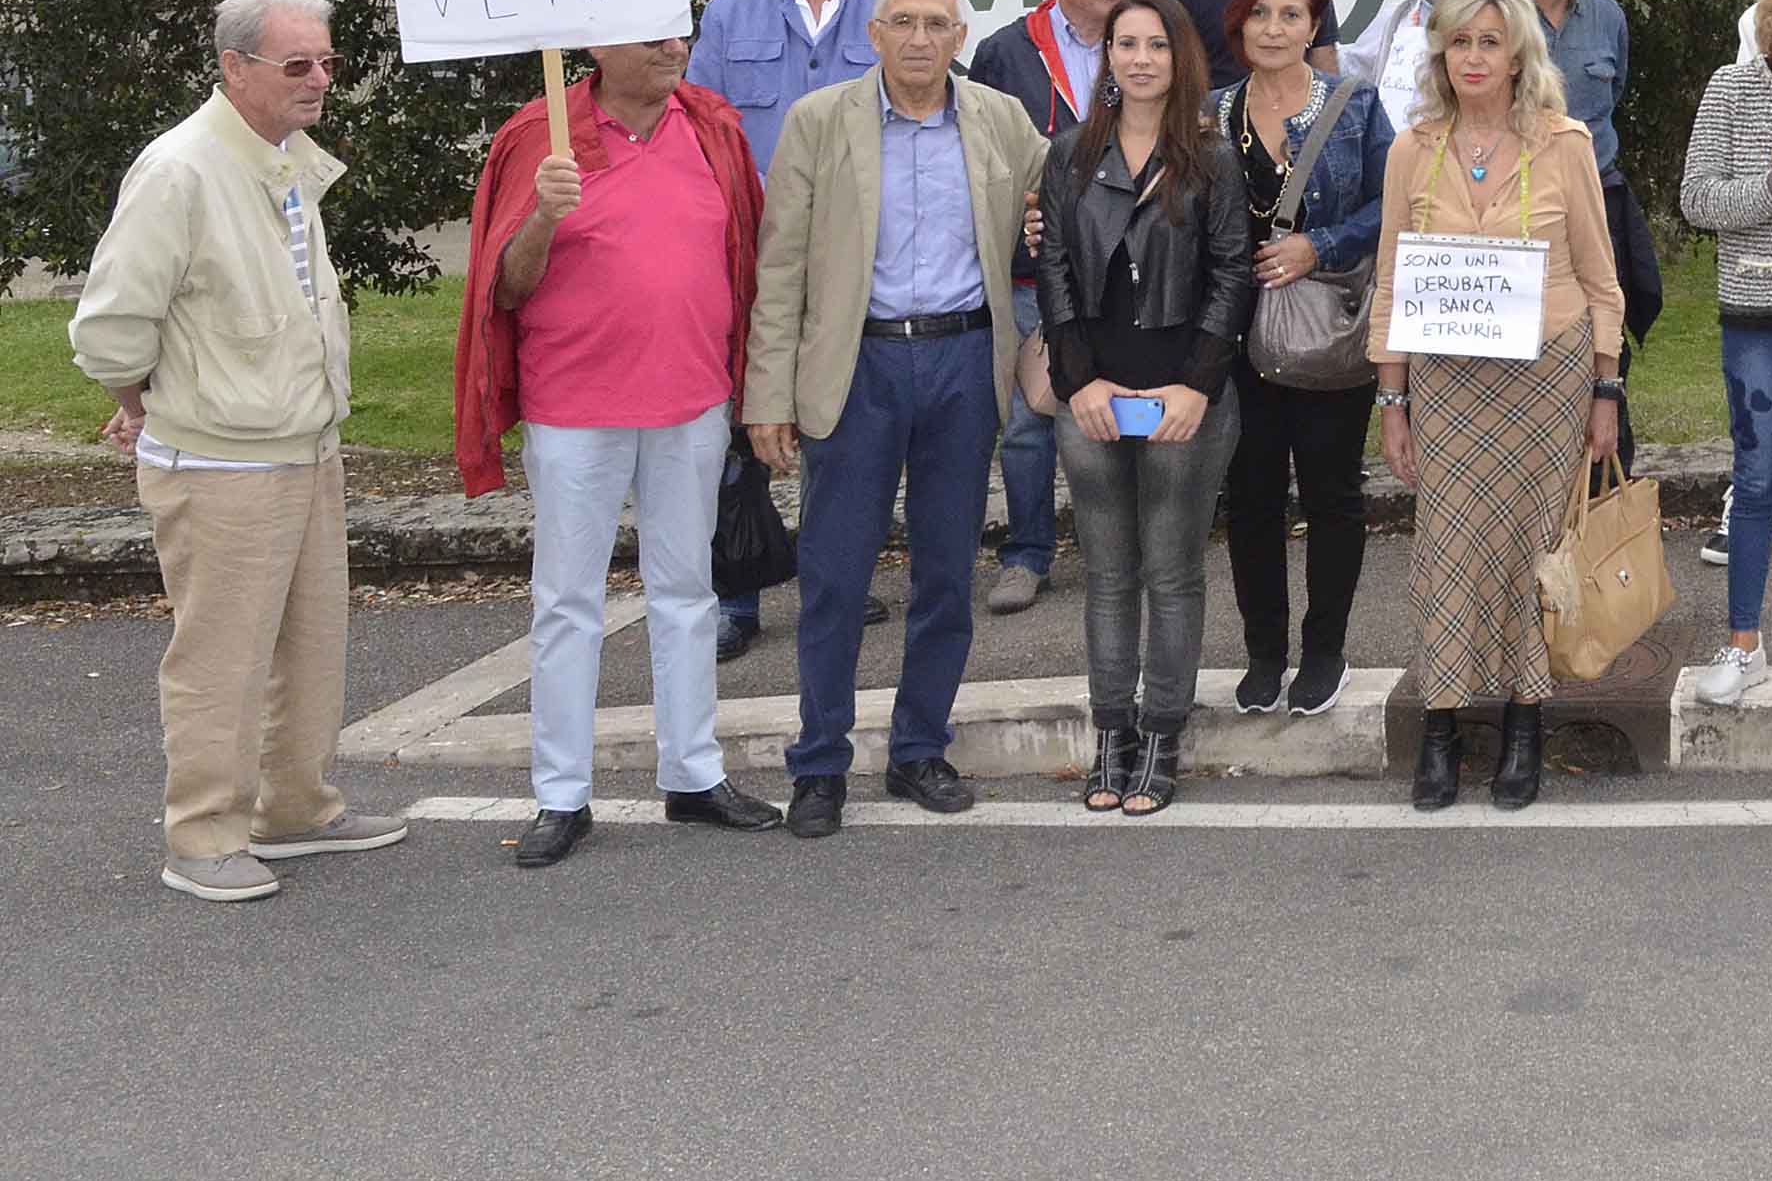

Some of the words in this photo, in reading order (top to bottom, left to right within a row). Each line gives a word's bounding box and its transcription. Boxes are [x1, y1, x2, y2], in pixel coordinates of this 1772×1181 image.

[1402, 252, 1452, 267] SONO
[1464, 252, 1500, 268] UNA
[1414, 274, 1513, 295] DERUBATA
[1404, 299, 1424, 317] DI
[1439, 298, 1496, 315] BANCA
